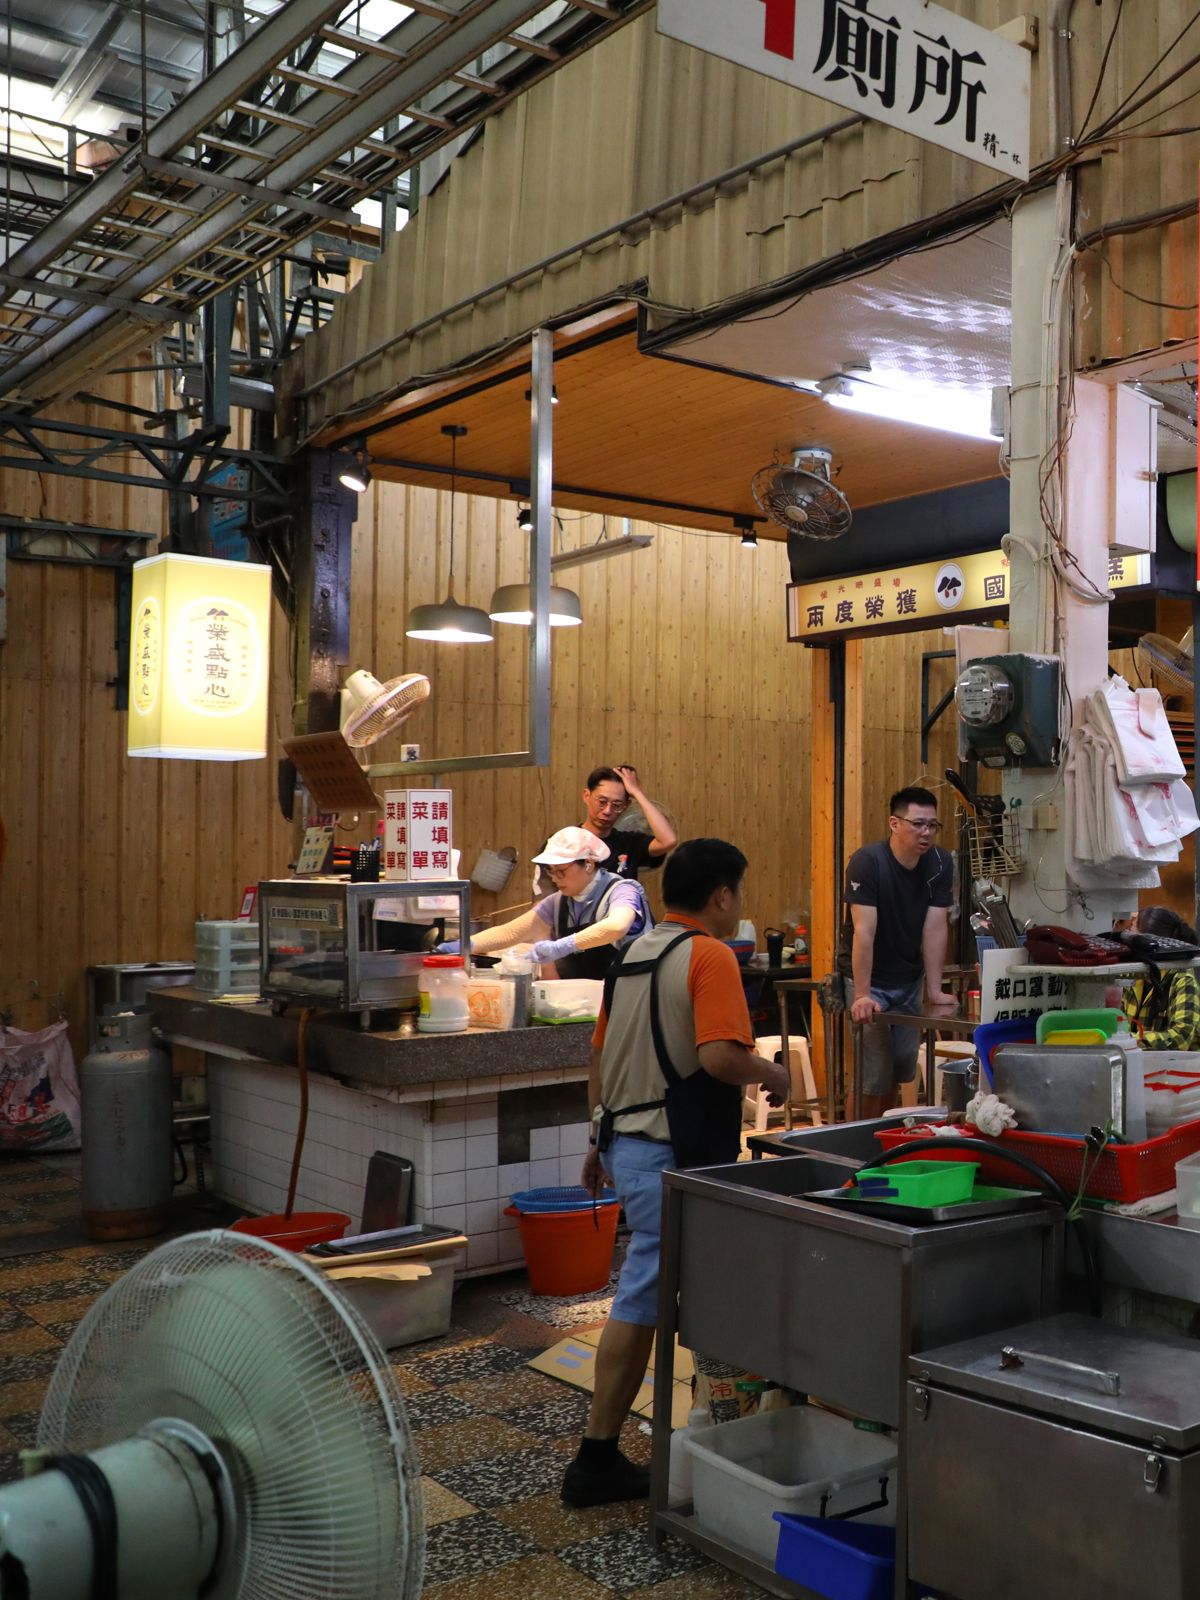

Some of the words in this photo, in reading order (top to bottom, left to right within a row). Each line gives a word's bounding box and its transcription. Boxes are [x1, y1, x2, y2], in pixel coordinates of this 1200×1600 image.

[812, 0, 987, 143] 廁所
[807, 588, 917, 628] 兩度榮獲
[984, 574, 1005, 600] 國
[397, 802, 407, 870] 請填寫
[412, 801, 429, 870] 菜單
[432, 801, 449, 870] 請填寫
